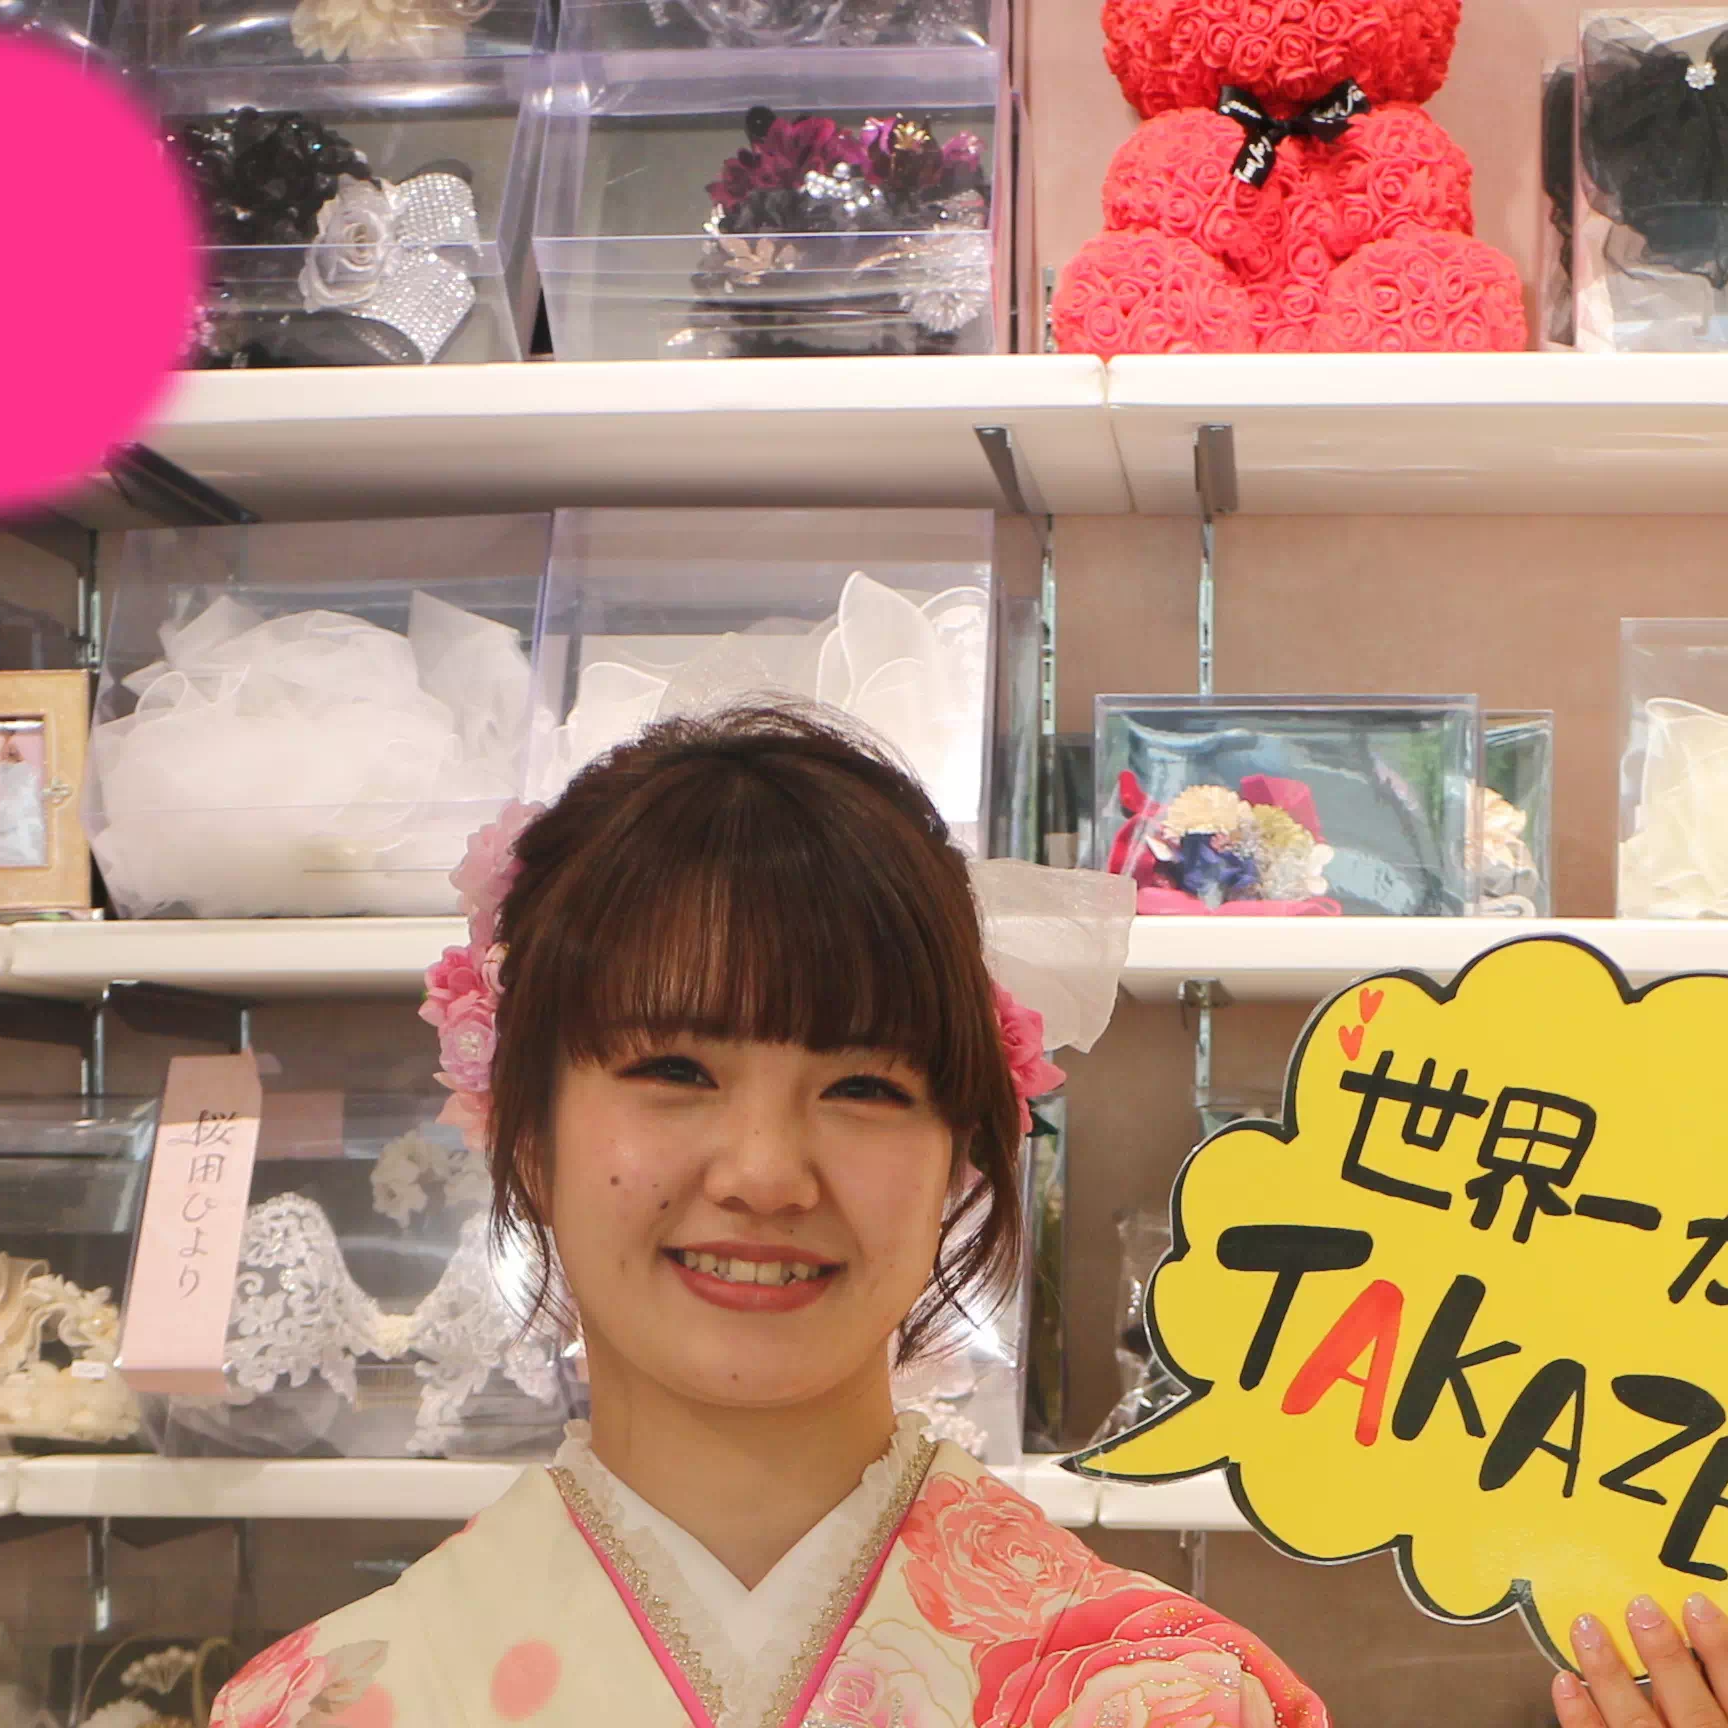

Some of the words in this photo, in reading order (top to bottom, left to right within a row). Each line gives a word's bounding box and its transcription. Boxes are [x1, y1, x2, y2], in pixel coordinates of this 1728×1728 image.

[166, 1109, 239, 1299] 桜田ひより
